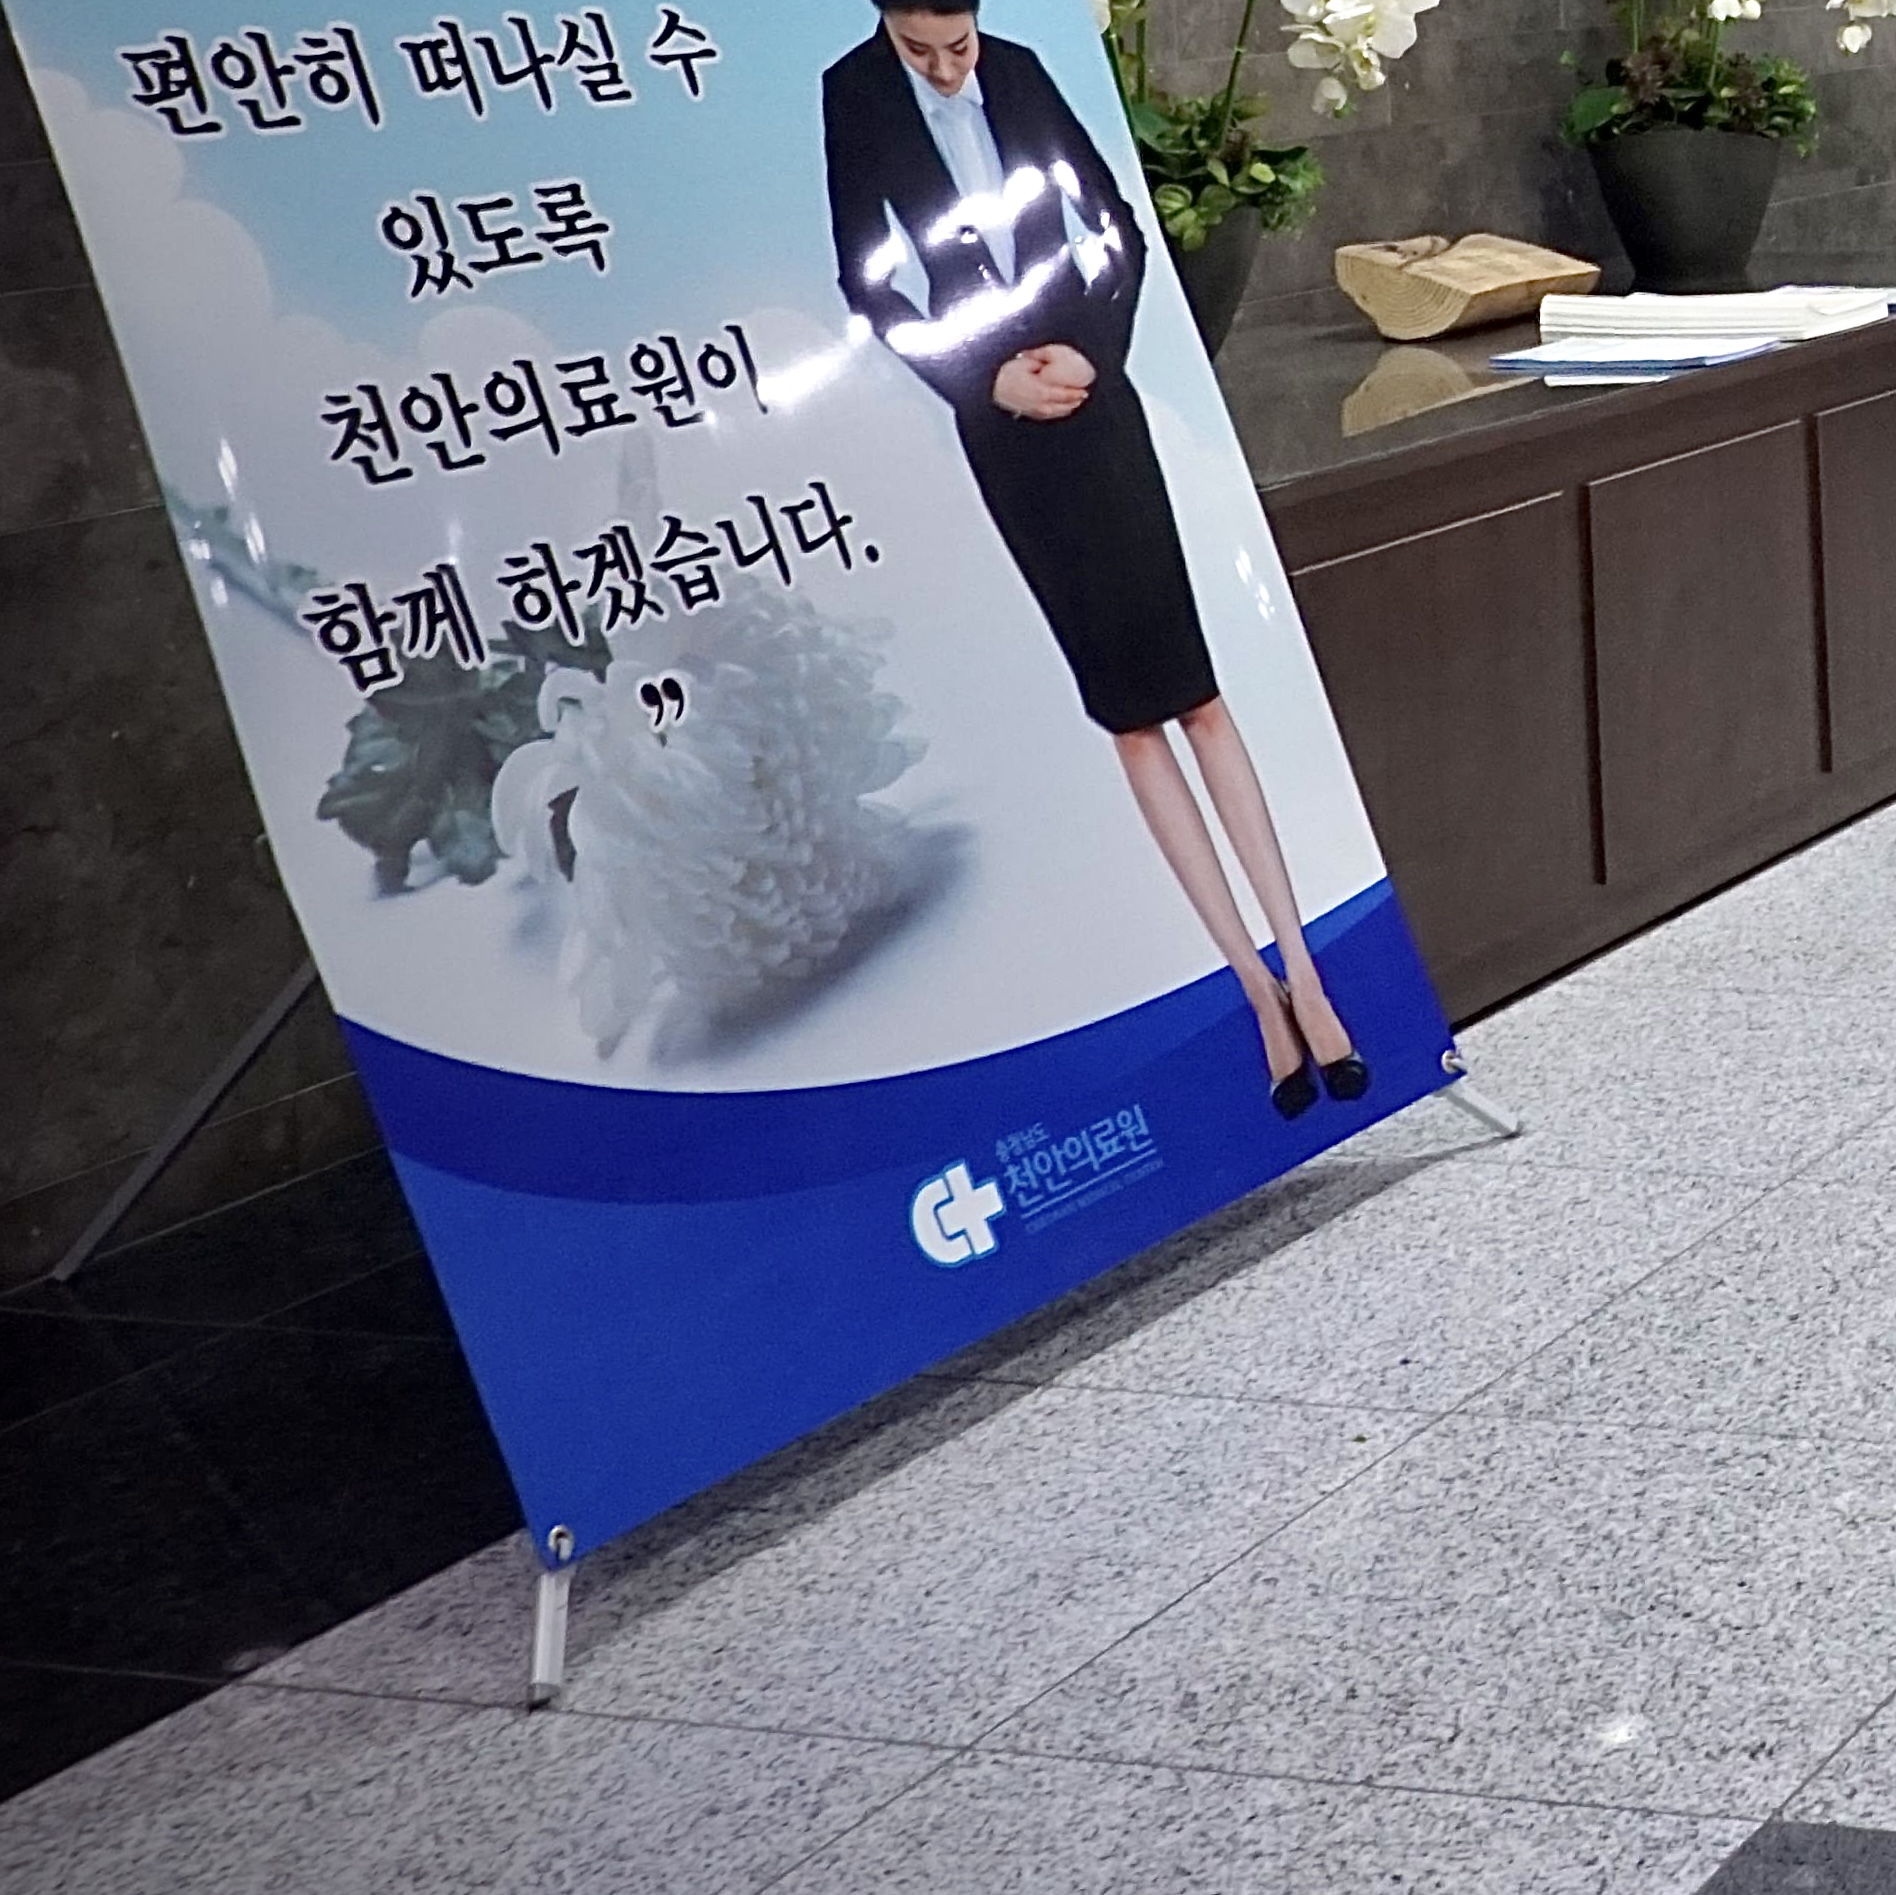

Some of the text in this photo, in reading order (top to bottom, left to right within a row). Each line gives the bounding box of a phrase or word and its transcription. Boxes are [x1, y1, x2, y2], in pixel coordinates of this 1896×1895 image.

[121, 6, 720, 137] 편안히 떠나실 수
[380, 181, 611, 299] 있도록
[320, 323, 770, 488] 천안의료원이
[302, 480, 881, 693] 함께 하겠습니다.
[1003, 1103, 1154, 1209] 천안의료원
